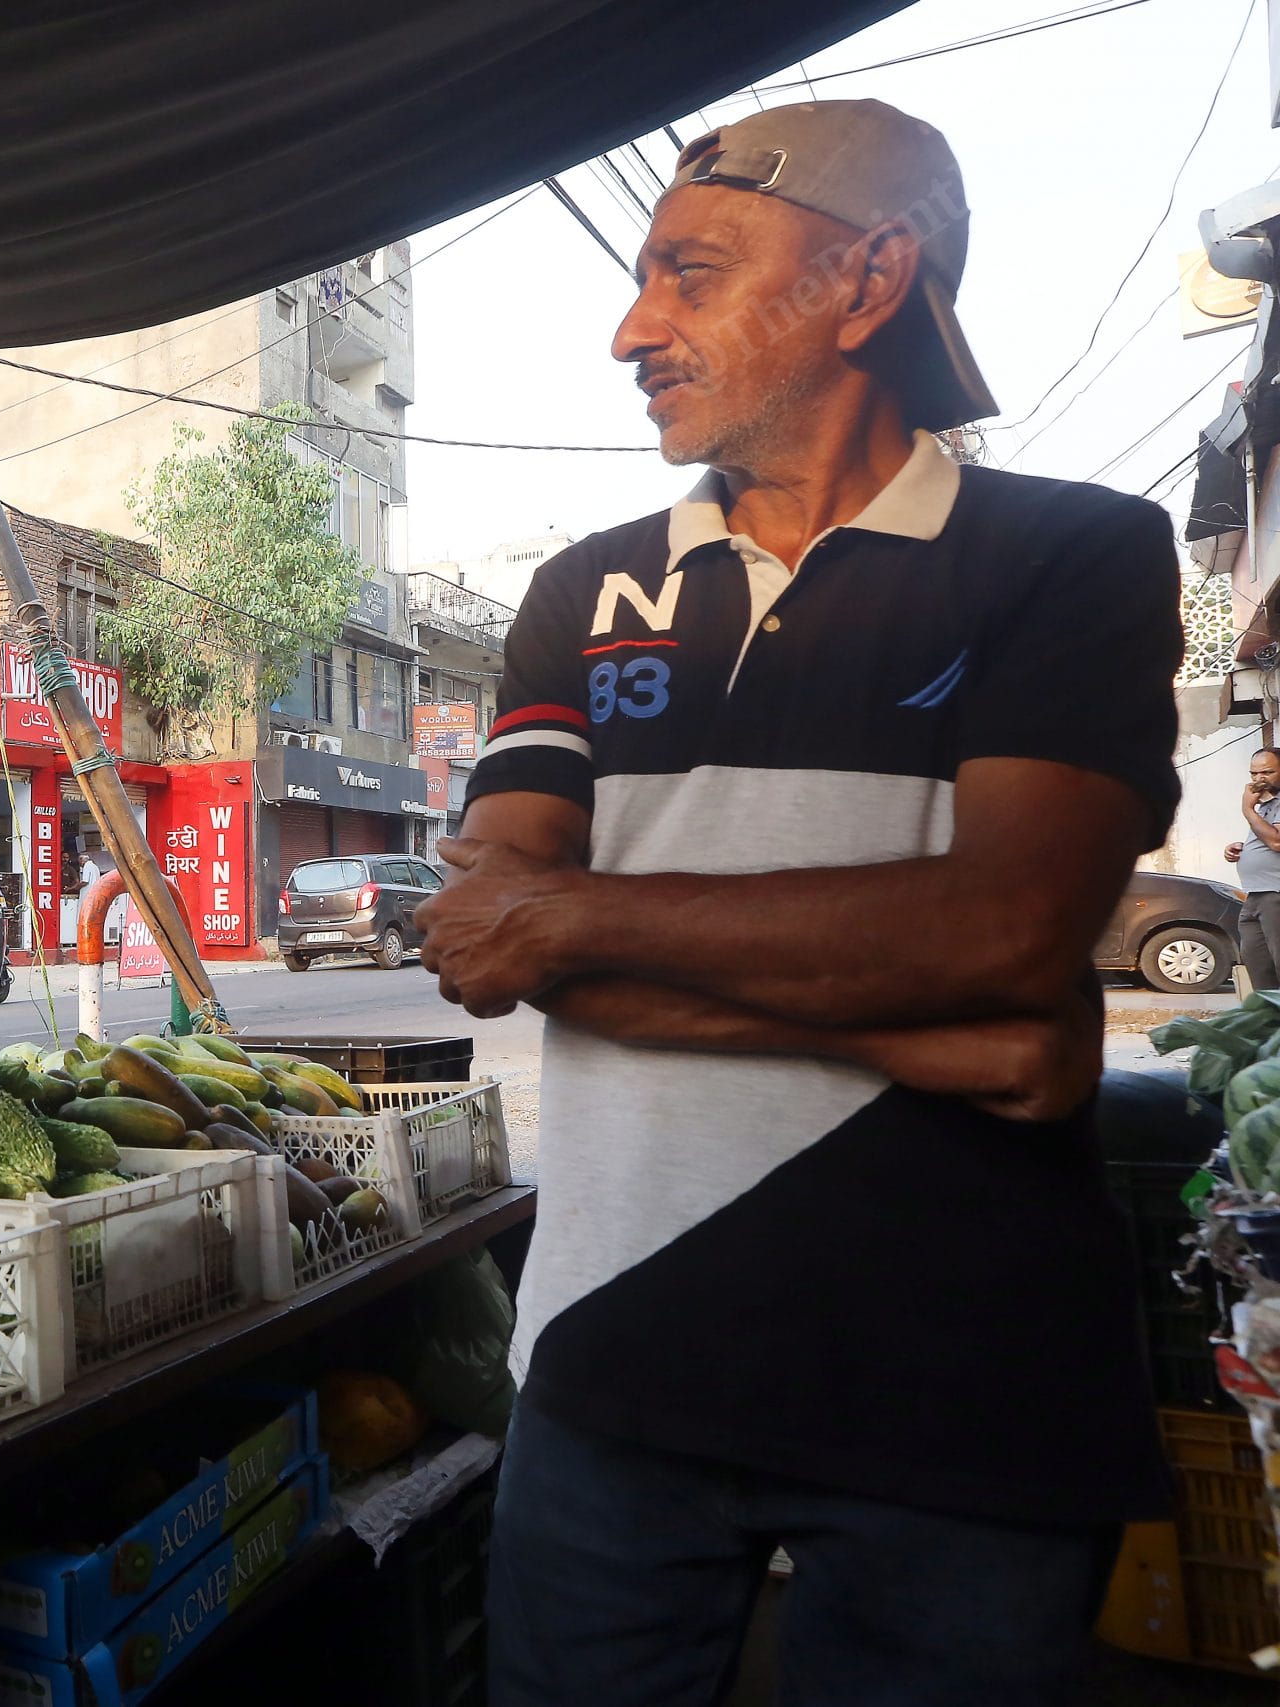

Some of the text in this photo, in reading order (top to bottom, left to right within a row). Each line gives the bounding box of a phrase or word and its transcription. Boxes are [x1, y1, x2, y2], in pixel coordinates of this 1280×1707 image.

[590, 571, 683, 637] N
[9, 653, 48, 707] WI
[589, 656, 671, 724] 83
[287, 784, 320, 800] Fabric
[38, 822, 53, 909] BEER
[166, 825, 199, 848] ठंडी
[209, 806, 232, 911] WINE
[126, 922, 154, 948] SHO
[204, 914, 240, 931] SHOP
[158, 1484, 219, 1565] ACME
[166, 1565, 229, 1654] ACME
